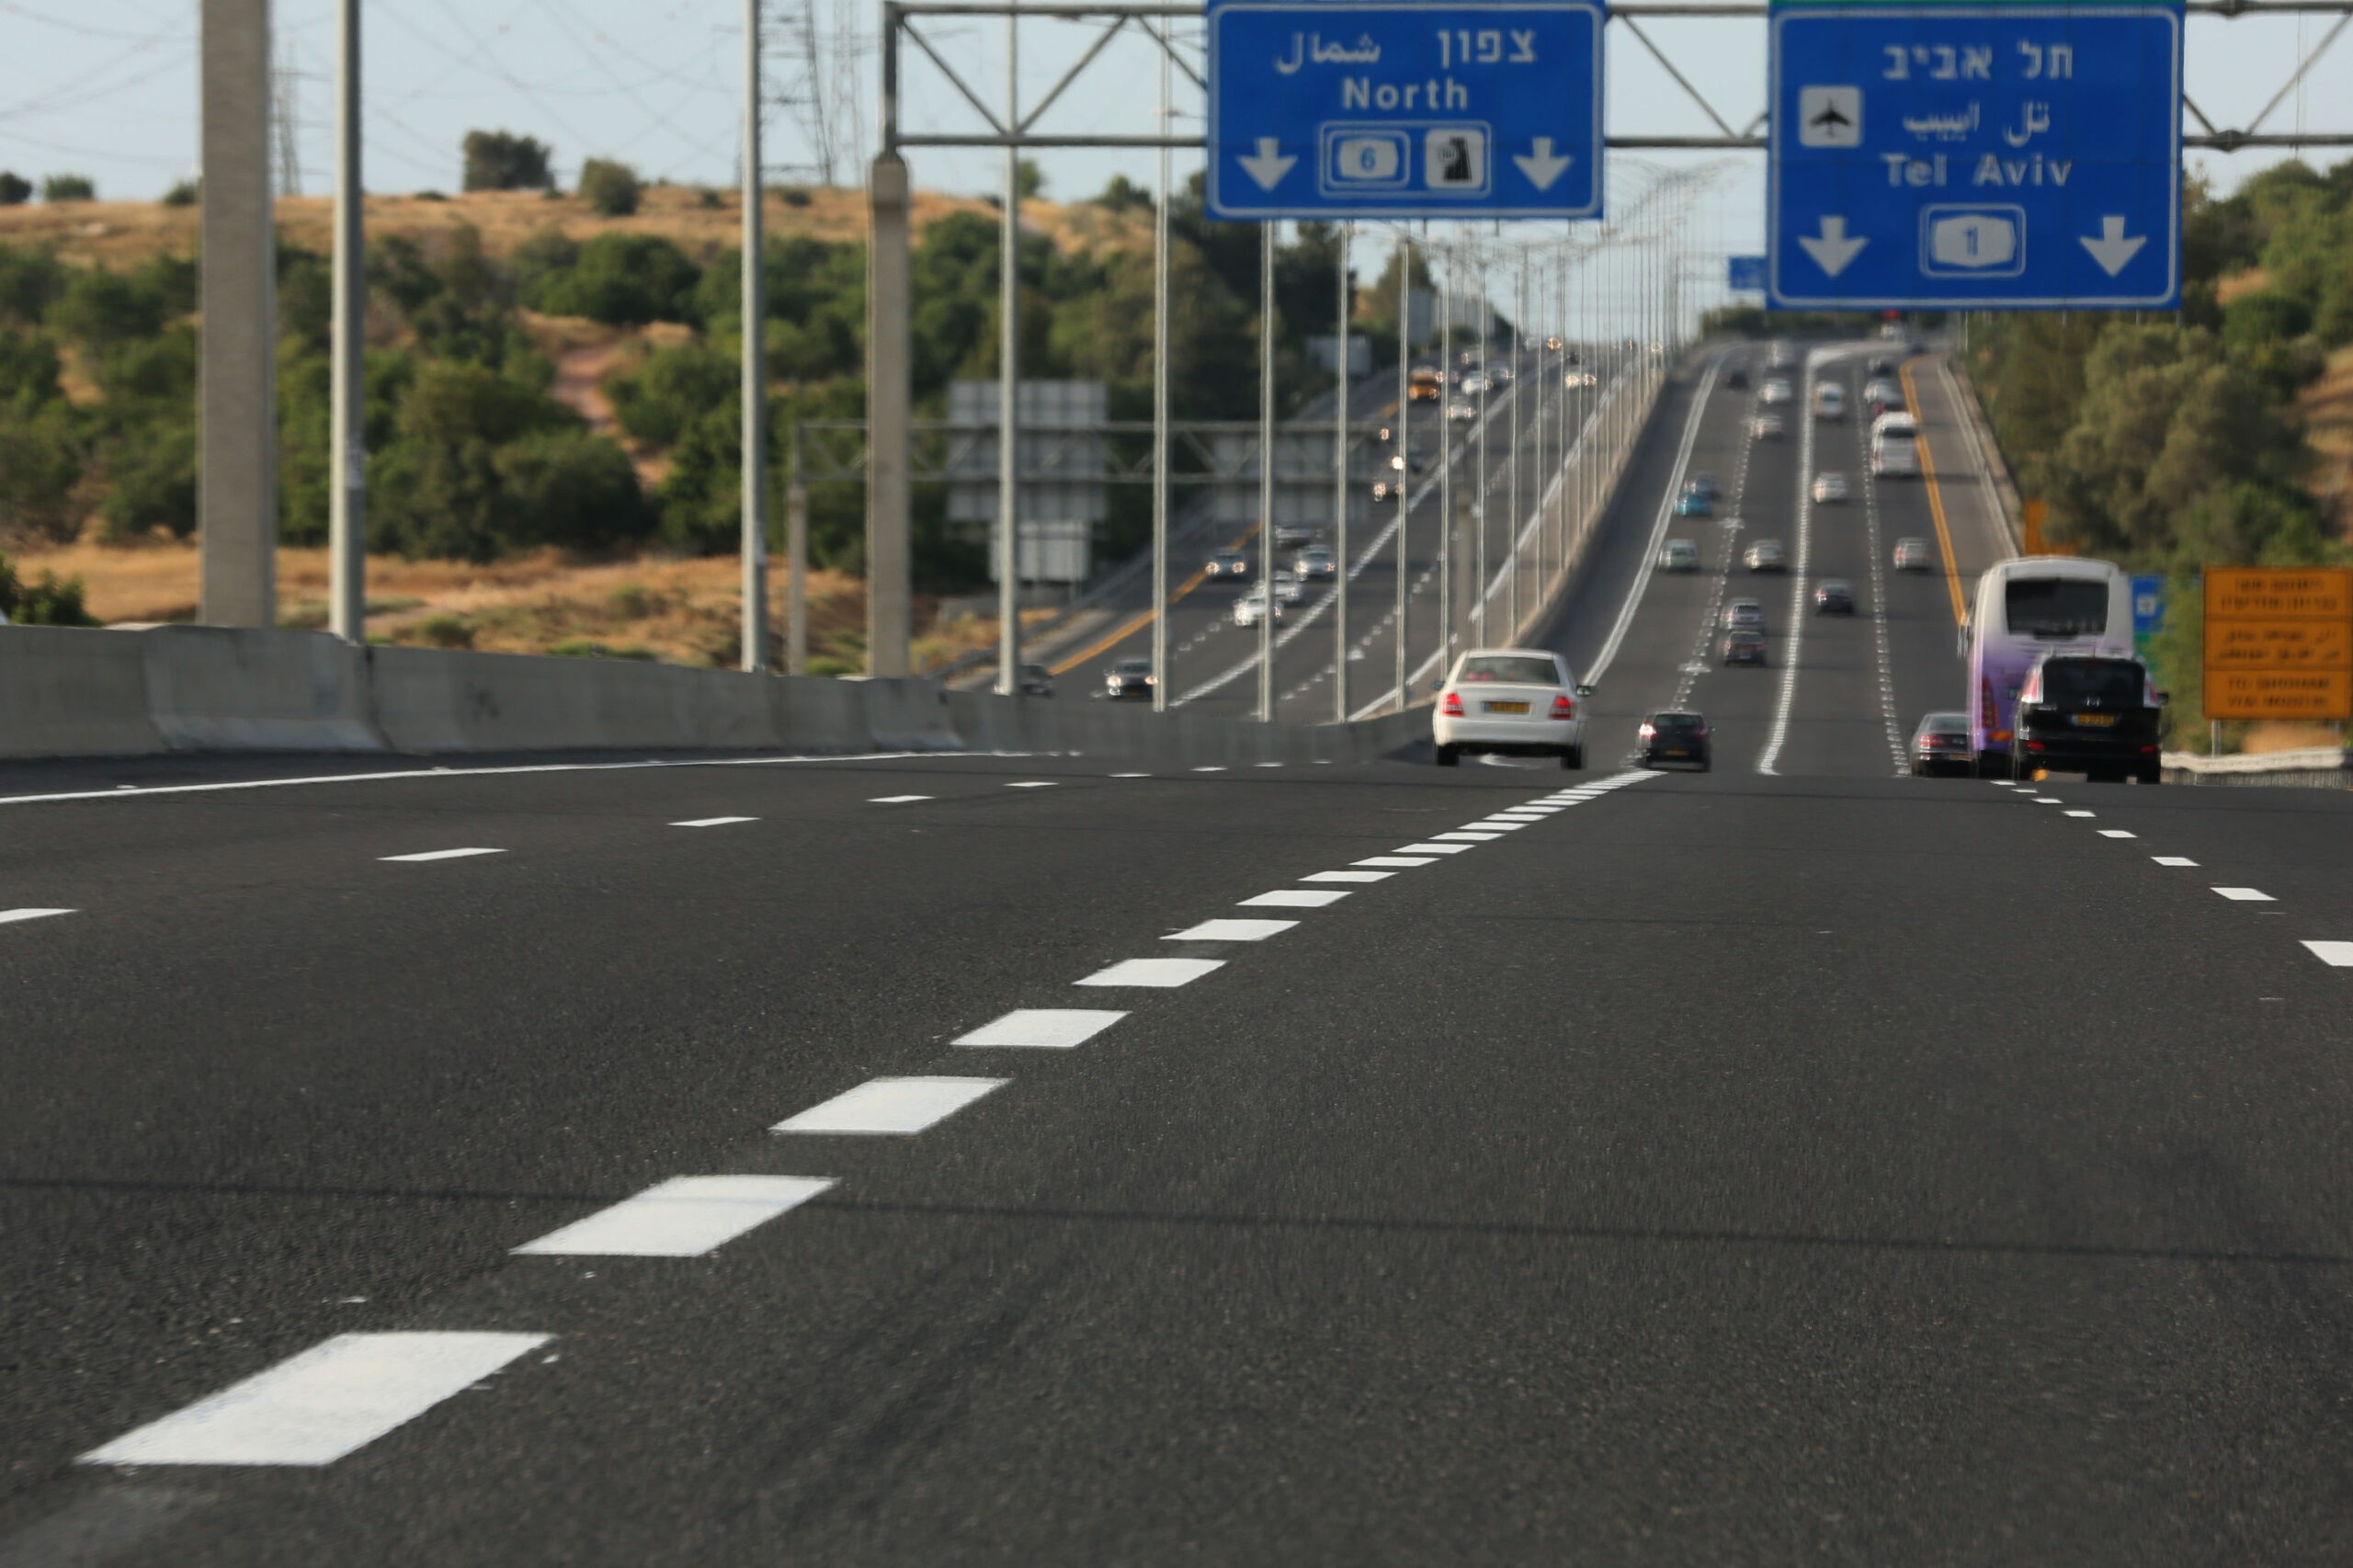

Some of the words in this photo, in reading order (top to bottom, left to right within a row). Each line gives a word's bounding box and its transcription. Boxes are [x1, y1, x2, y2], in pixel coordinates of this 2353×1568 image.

[1274, 33, 1381, 74] شمال
[1438, 29, 1538, 69] צפון
[1882, 45, 1993, 80] אביב
[2017, 40, 2074, 80] תל
[1342, 77, 1469, 109] North
[2003, 99, 2051, 147] تل
[1359, 146, 1376, 173] 6
[1881, 153, 1948, 187] Tel
[1973, 153, 2073, 187] Aviv
[1961, 225, 1979, 256] 1
